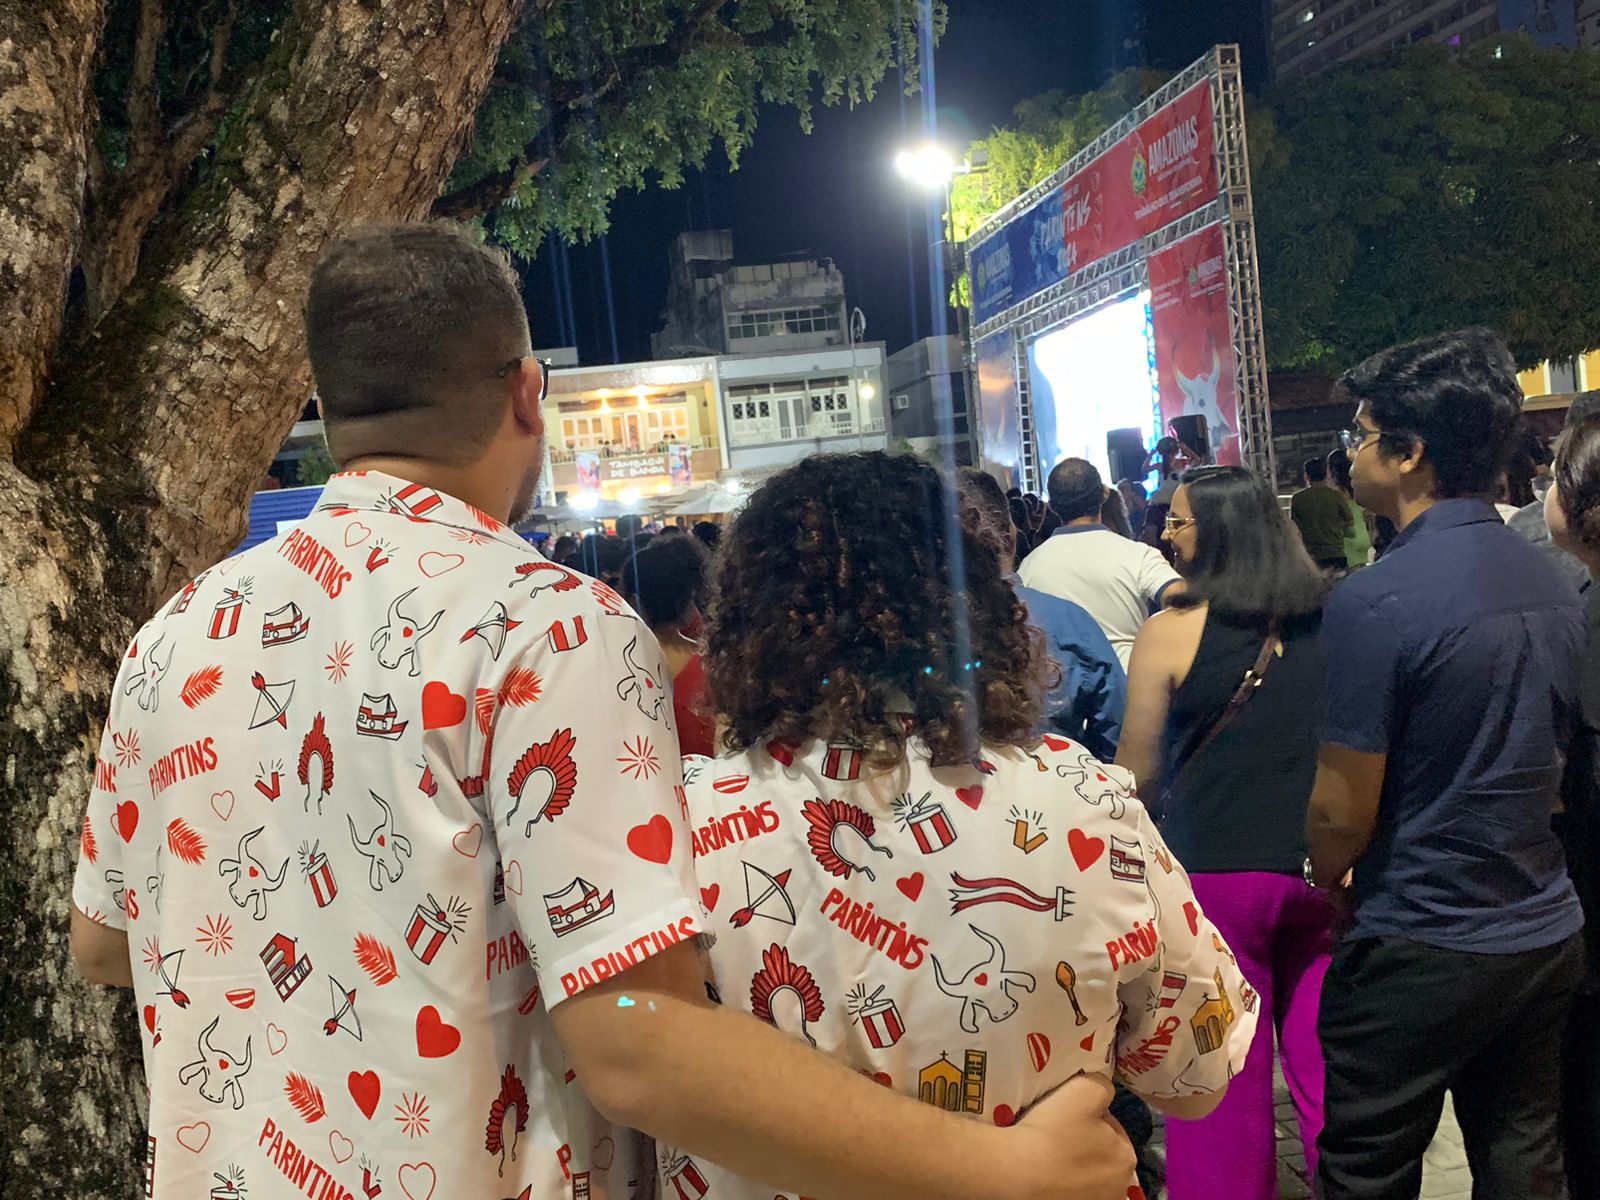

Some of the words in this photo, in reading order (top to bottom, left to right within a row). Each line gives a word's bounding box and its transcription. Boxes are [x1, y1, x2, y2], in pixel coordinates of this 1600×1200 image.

[1148, 115, 1199, 177] AMAZONAS
[277, 527, 353, 600] PARINTINS
[148, 736, 218, 800] PARINTINS
